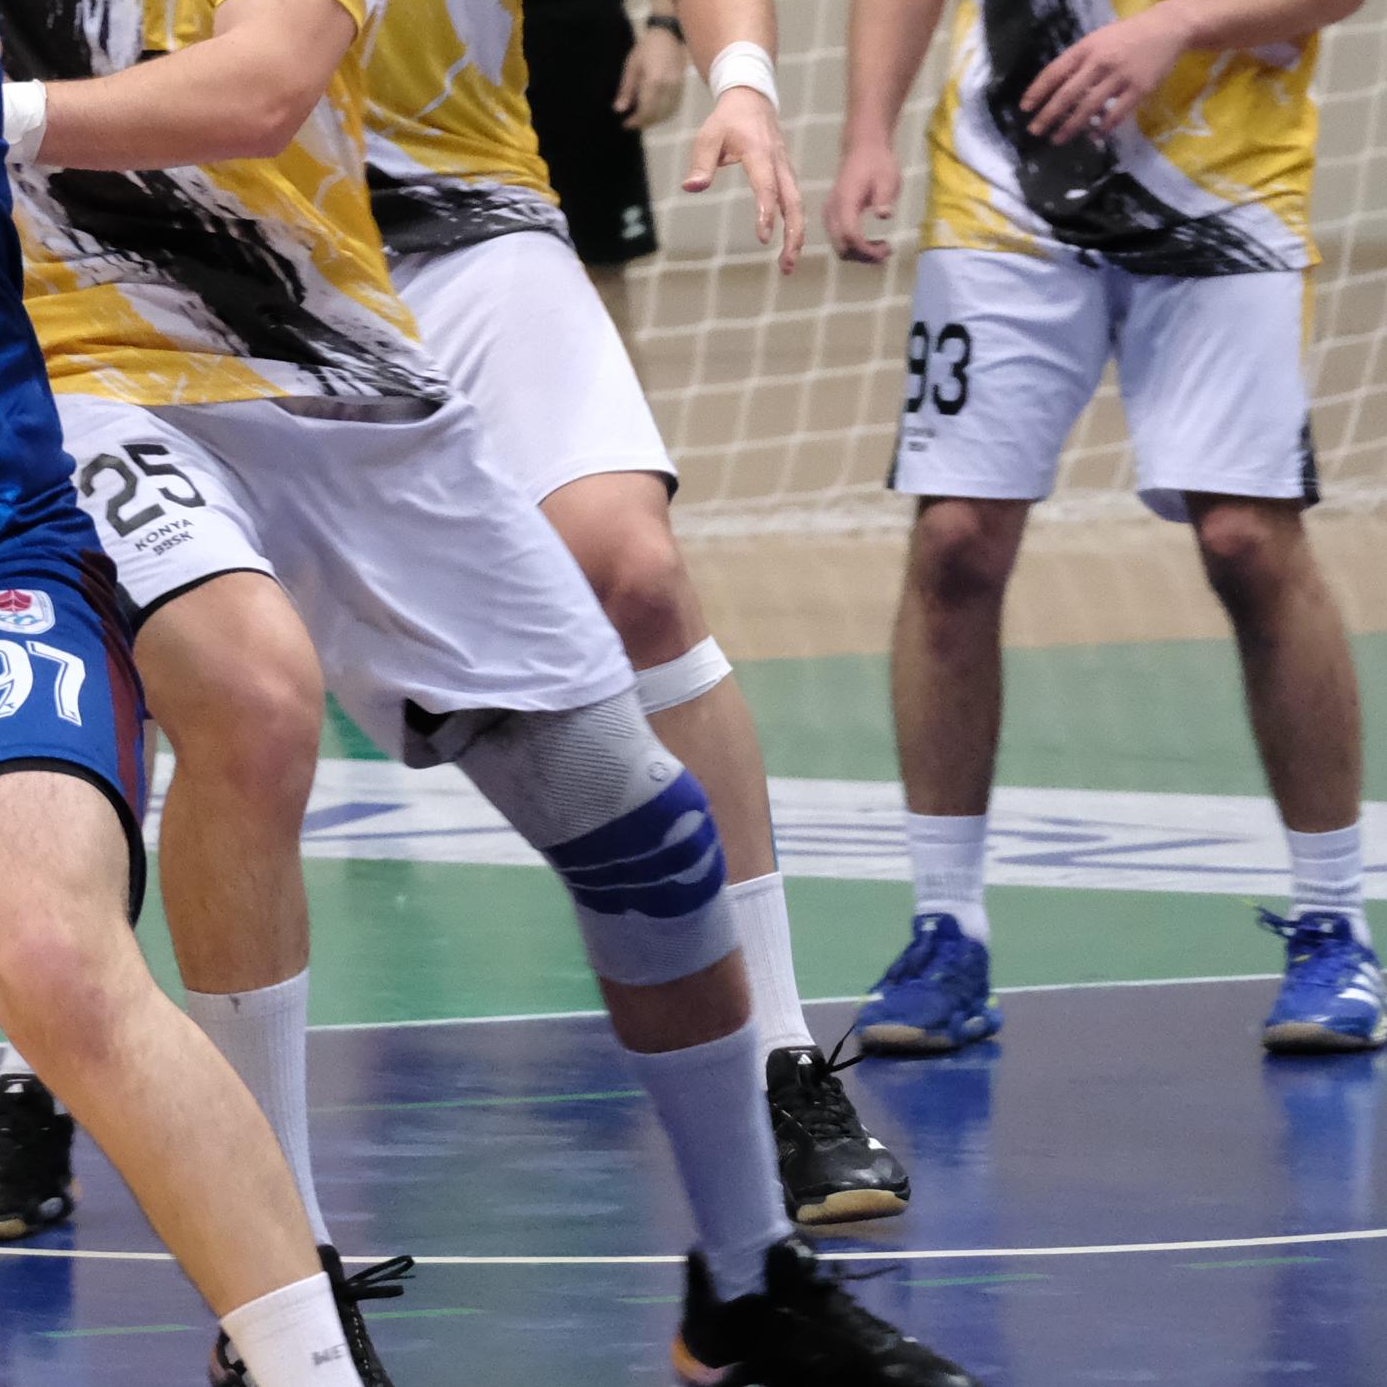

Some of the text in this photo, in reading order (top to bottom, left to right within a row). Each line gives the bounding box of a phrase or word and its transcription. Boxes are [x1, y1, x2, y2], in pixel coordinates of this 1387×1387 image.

[904, 321, 972, 416] 93
[79, 443, 207, 538] 25
[134, 518, 195, 552] KONYA
